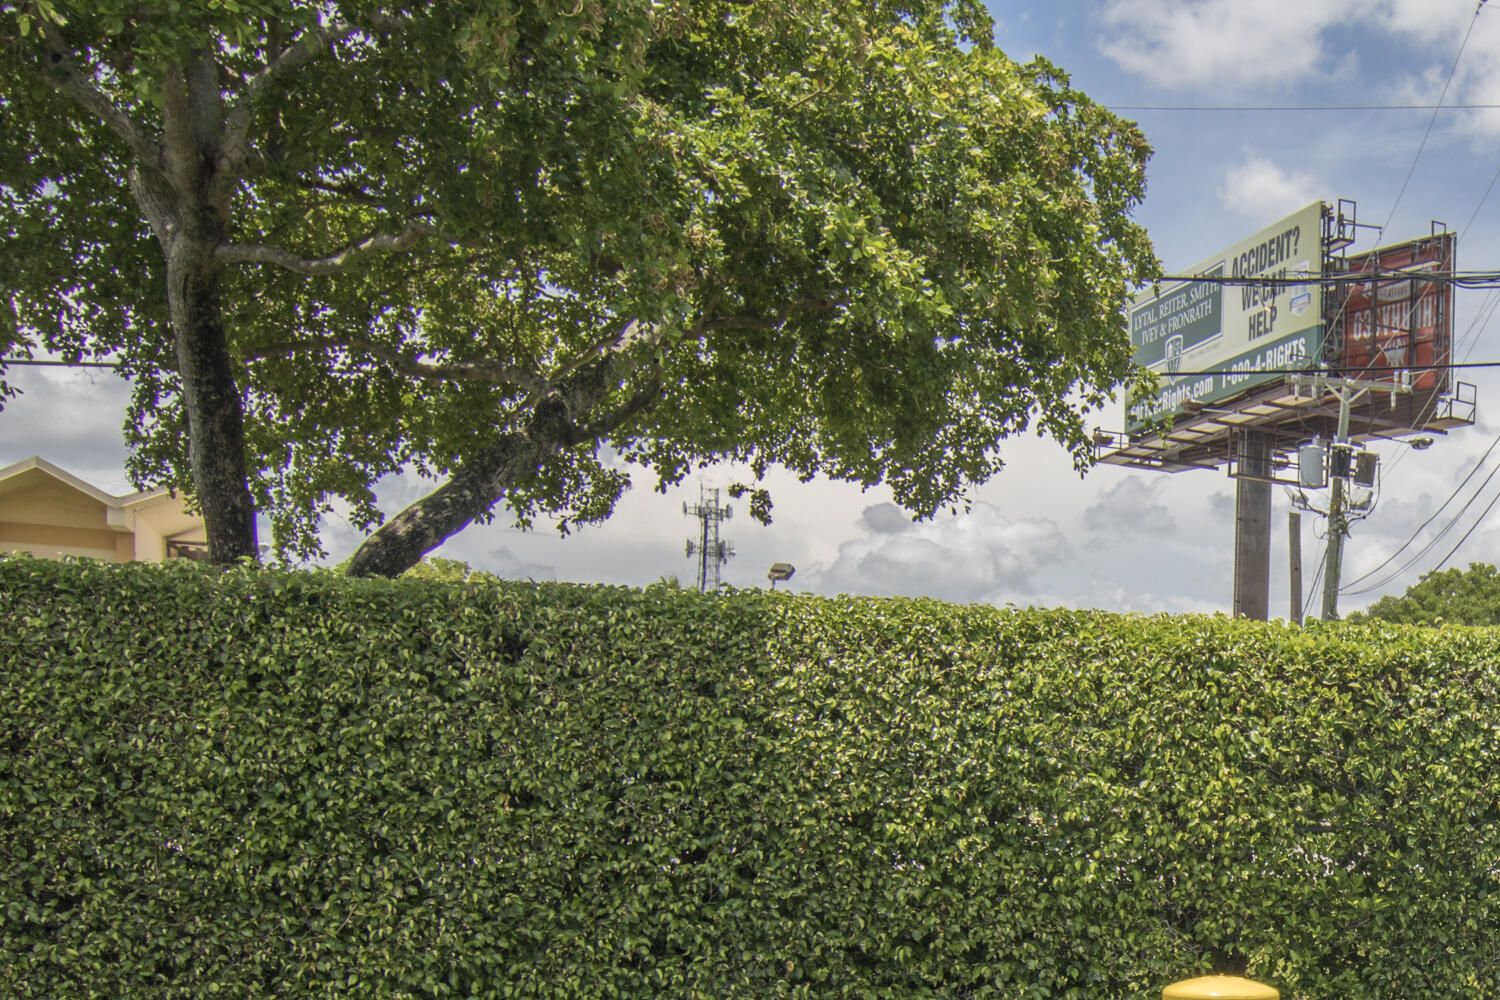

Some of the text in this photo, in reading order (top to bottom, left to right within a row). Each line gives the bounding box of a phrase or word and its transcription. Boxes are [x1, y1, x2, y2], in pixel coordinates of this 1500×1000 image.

[1231, 225, 1300, 279] ACCIDENT?
[1134, 279, 1220, 331] LYTAL, REITER, SMITH,
[1242, 279, 1259, 311] WE
[1262, 267, 1286, 302] CAN
[1142, 299, 1212, 345] IVEY & FRONRATH
[1249, 305, 1278, 342] HELP
[1222, 336, 1306, 389] 1-800-4-RIGHTS
